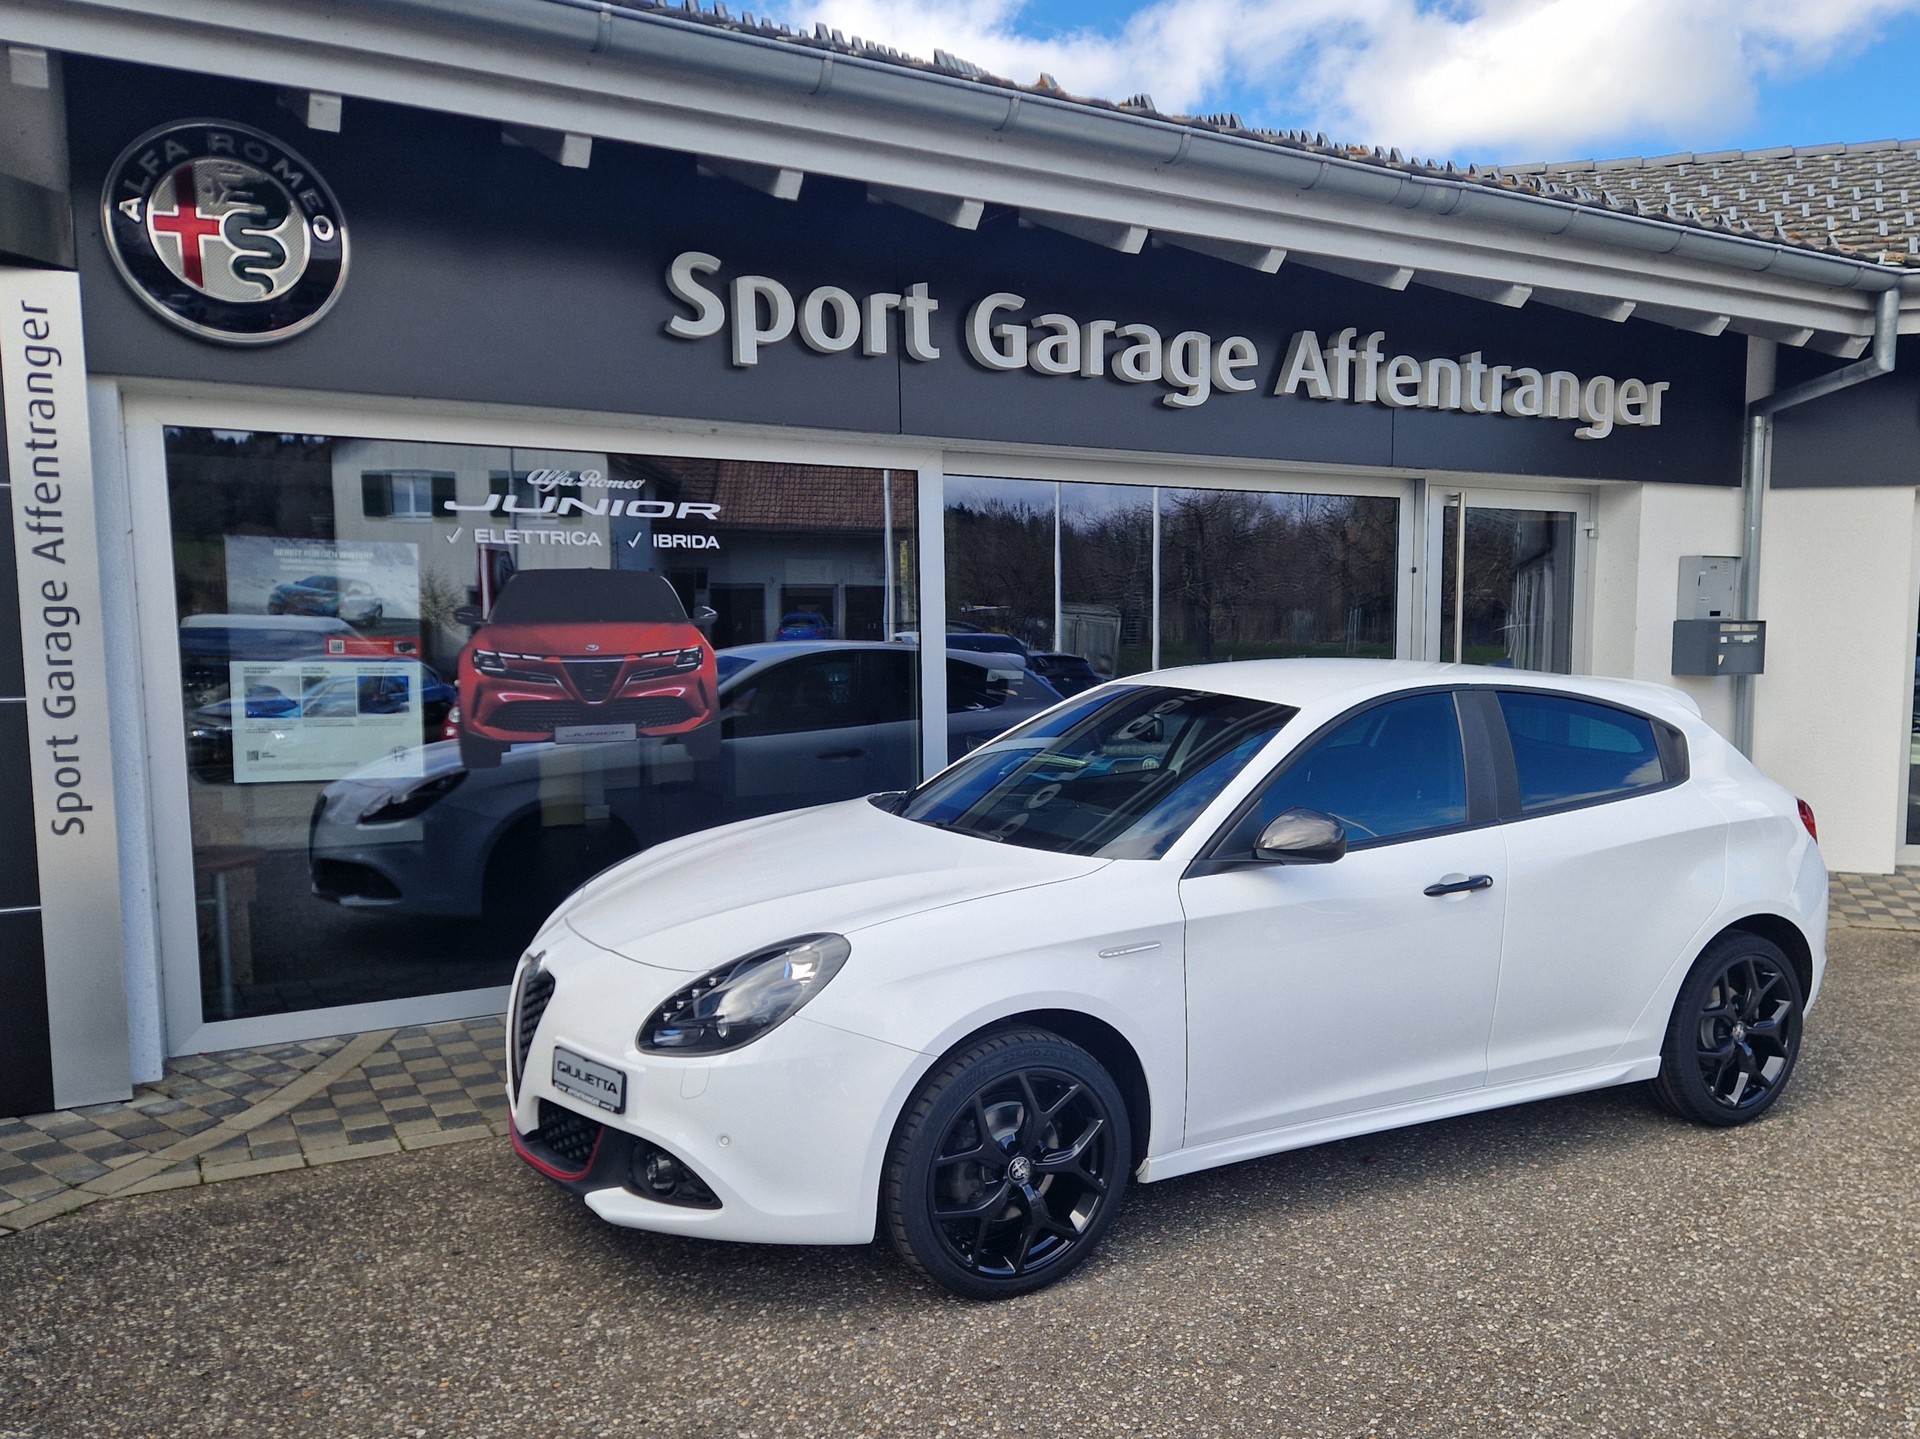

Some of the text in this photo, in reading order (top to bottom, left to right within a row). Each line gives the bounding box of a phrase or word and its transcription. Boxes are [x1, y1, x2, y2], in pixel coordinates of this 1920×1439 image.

[119, 132, 335, 242] ALFA ROMEO
[665, 251, 1670, 439] Sport Garage Affentranger
[527, 469, 645, 492] Alfa Romeo
[444, 494, 721, 520] JUNIOR
[474, 528, 720, 549] ELETTRICA IBRIDA
[20, 300, 92, 836] Sport Garage Affentranger
[558, 1060, 618, 1095] GIULIETTA
